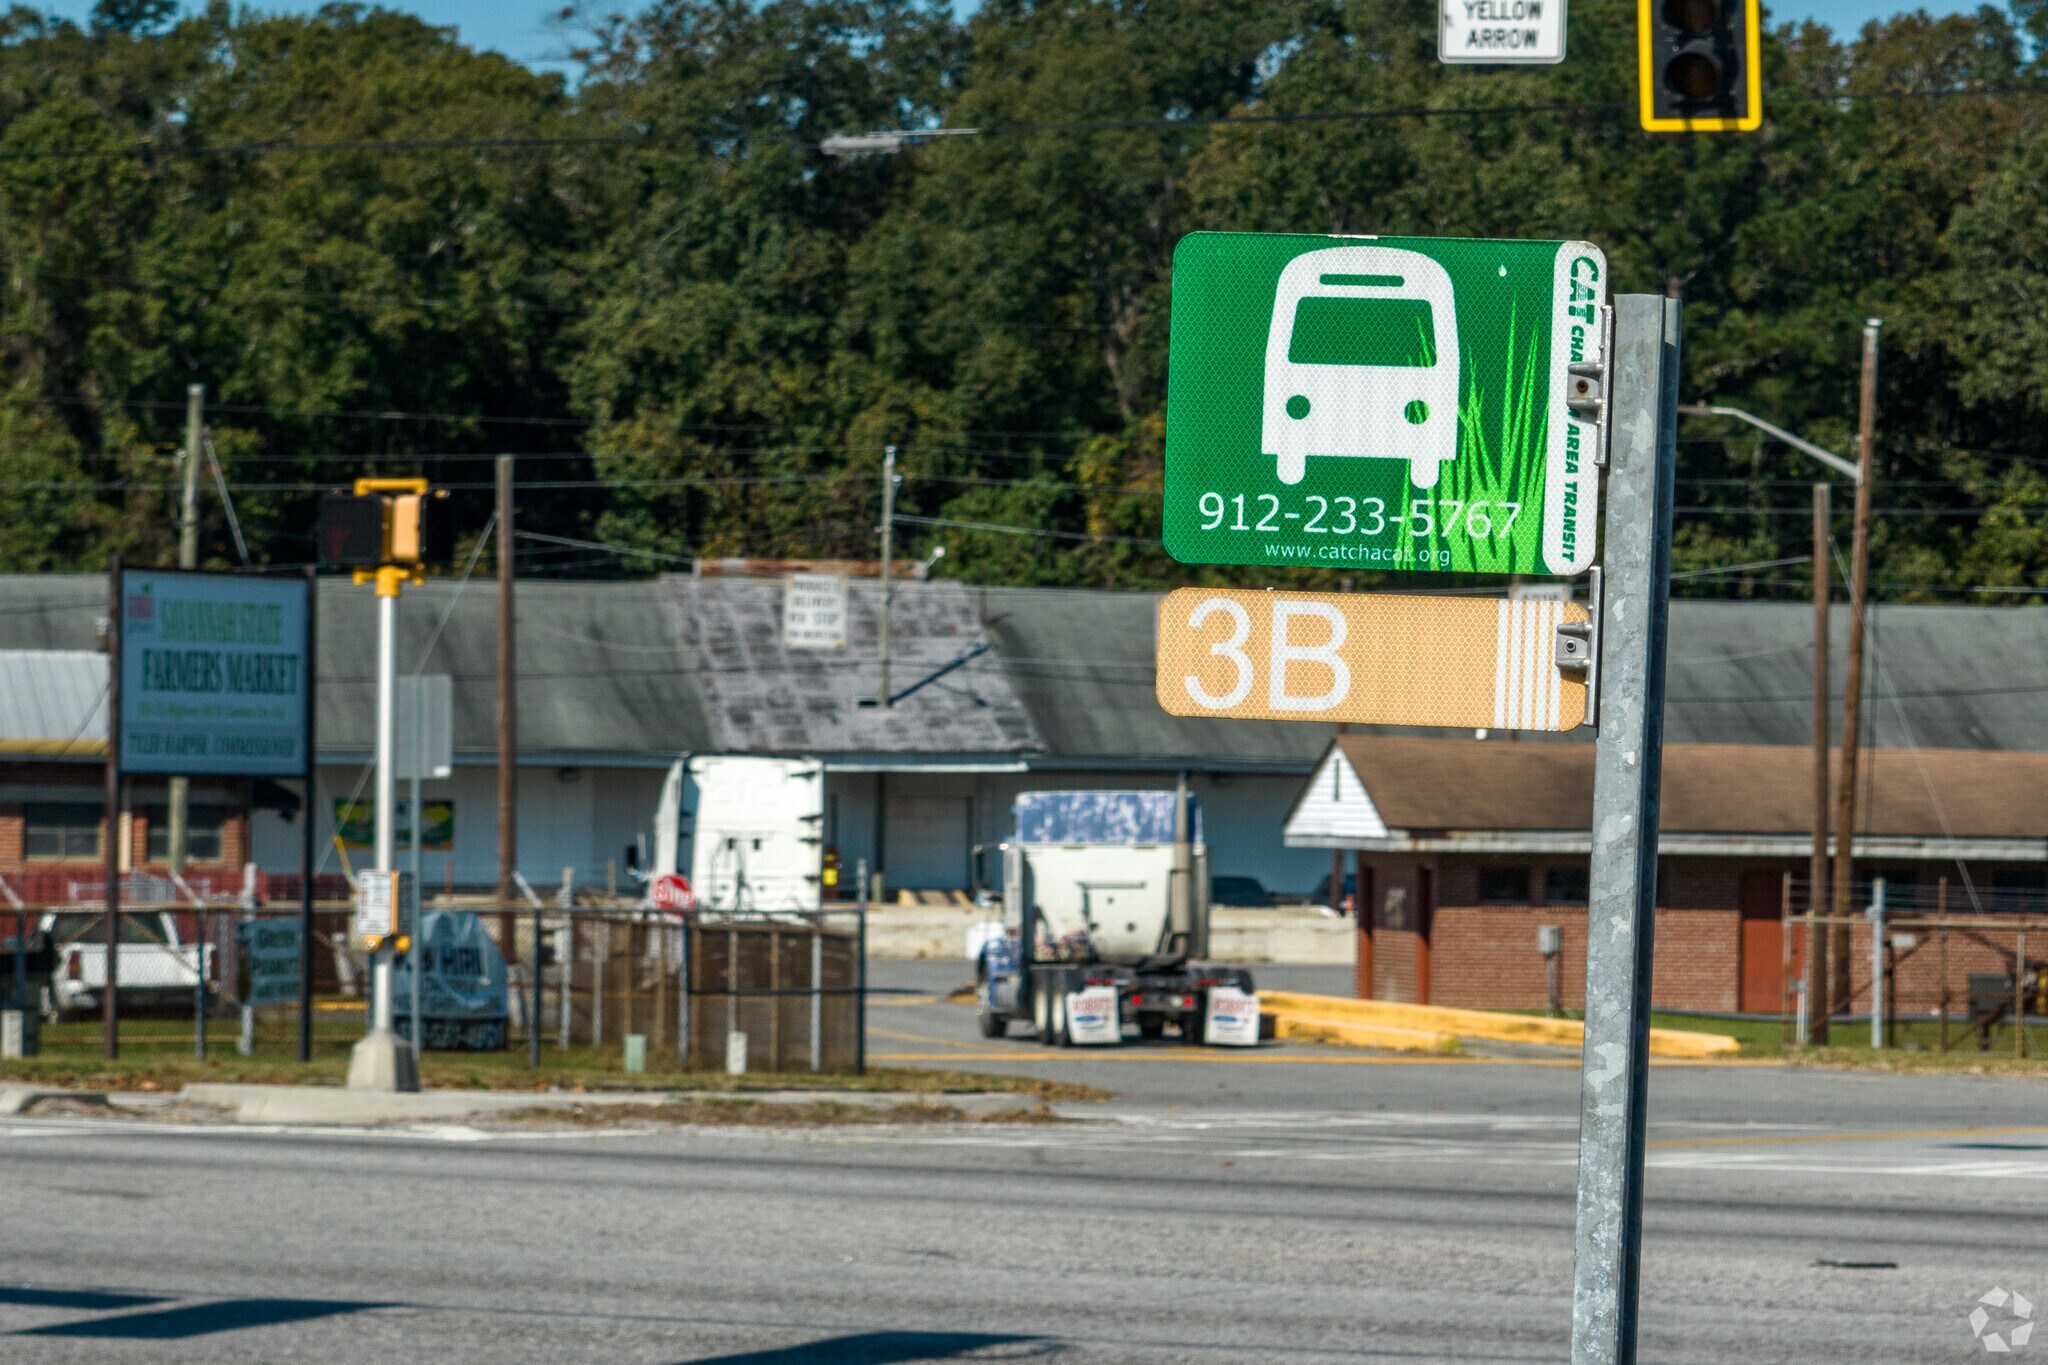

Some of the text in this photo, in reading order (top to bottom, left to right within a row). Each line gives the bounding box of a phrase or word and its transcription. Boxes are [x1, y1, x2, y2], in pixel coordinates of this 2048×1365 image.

[1464, 0, 1543, 20] YELLOW
[1465, 28, 1539, 49] ARROW
[1561, 256, 1599, 563] CAT CHAM AREA TRANSIT
[1198, 492, 1522, 539] 912-233-5767
[1265, 543, 1450, 567] www.catchacat.org
[142, 649, 298, 694] FARMERS MARKET
[1184, 598, 1351, 711] 3B
